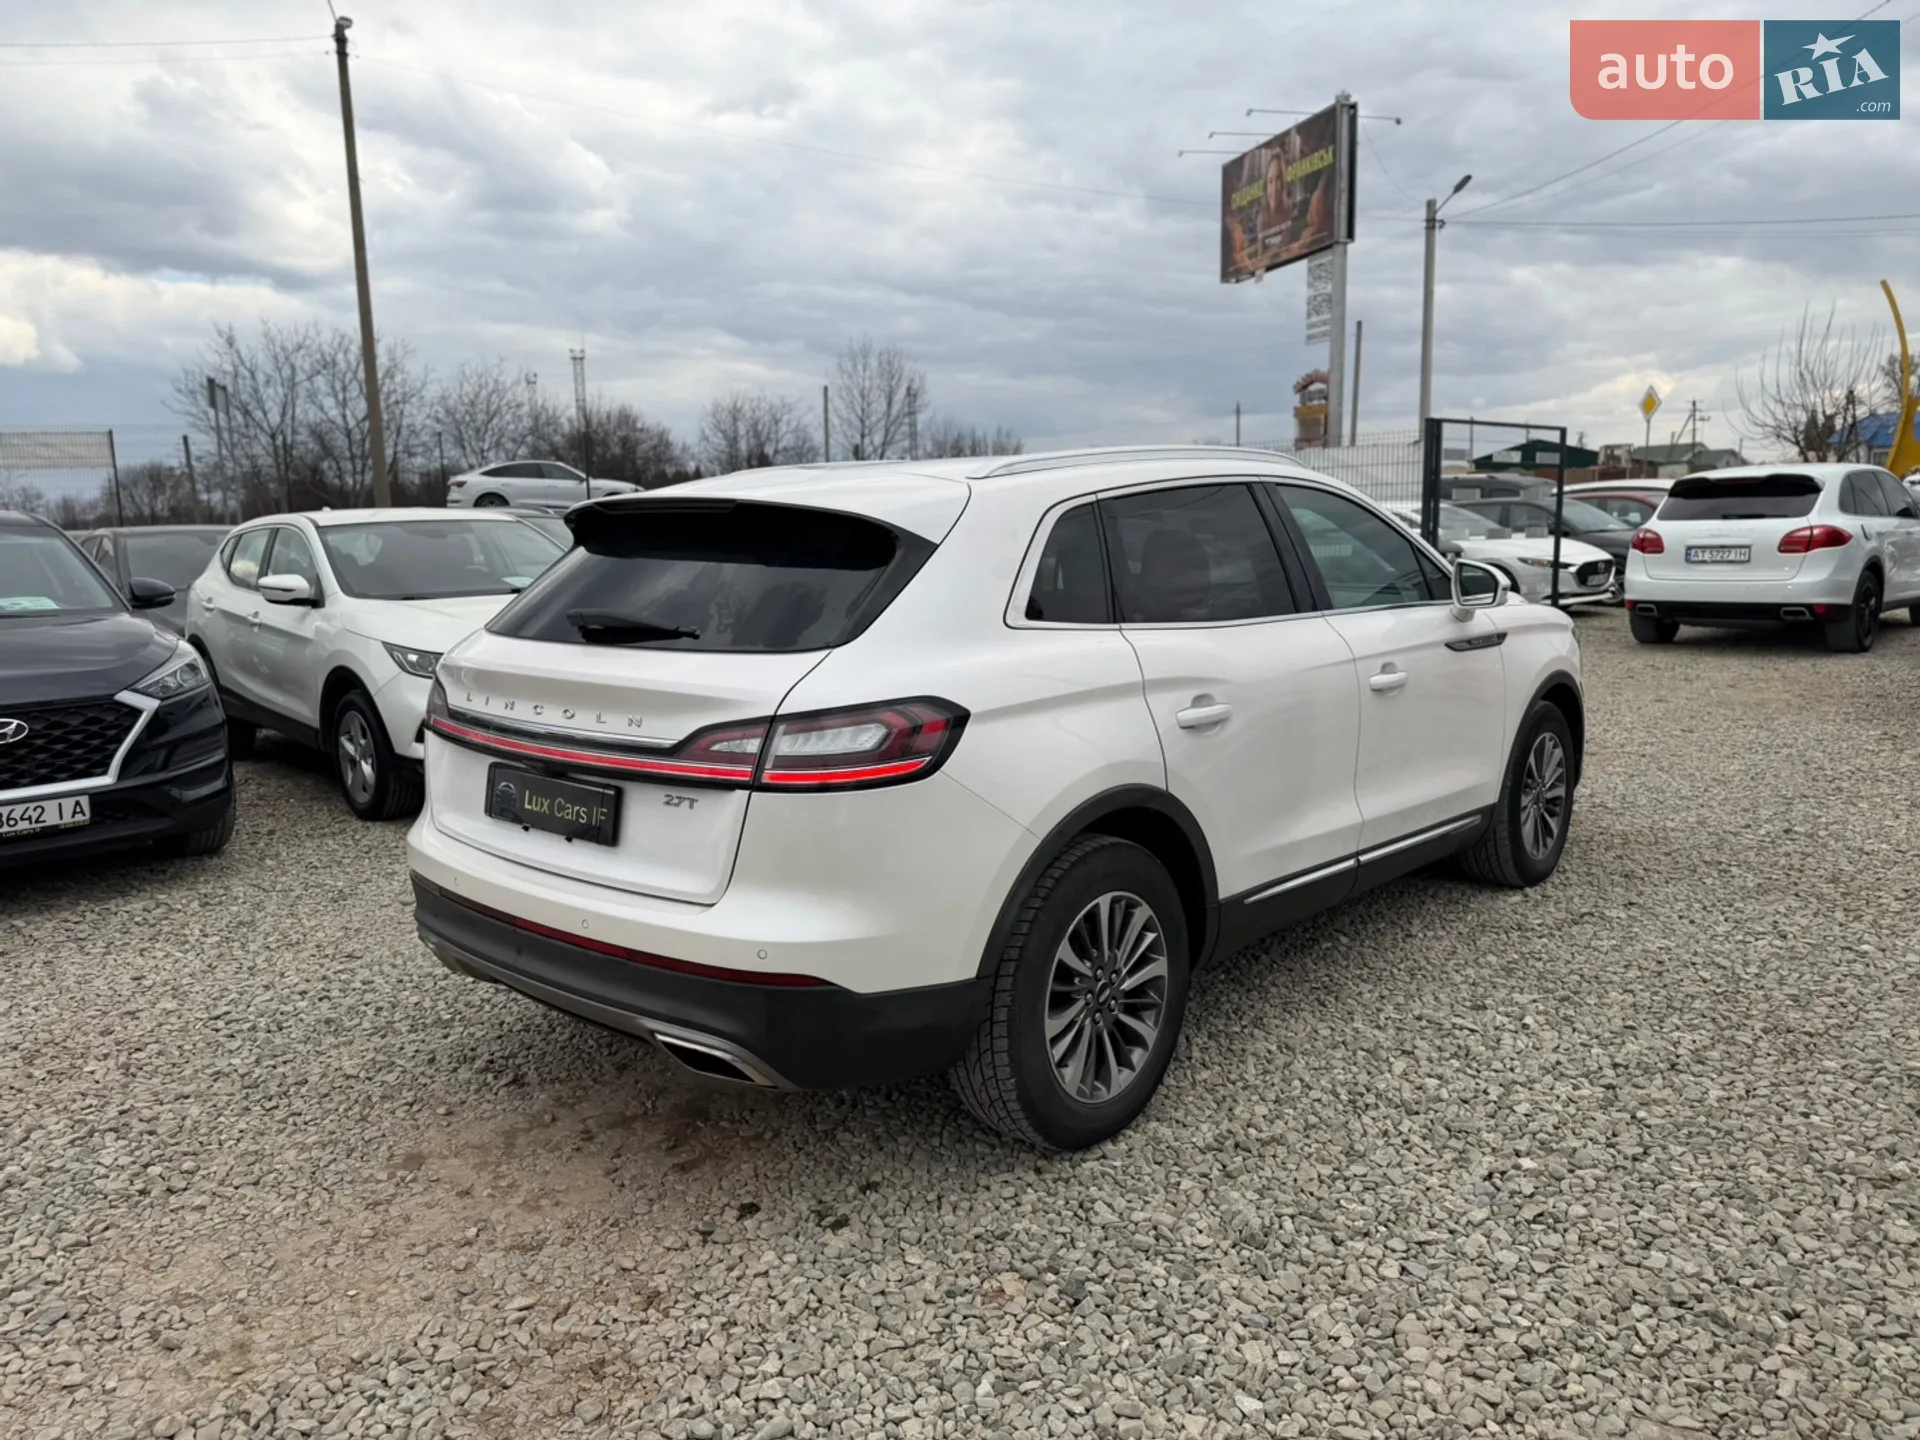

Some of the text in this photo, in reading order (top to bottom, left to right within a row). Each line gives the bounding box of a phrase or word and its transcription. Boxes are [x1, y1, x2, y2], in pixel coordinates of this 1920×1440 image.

[1692, 549, 1706, 560] AT
[466, 692, 643, 728] LINCOLN
[524, 789, 608, 827] Lux Cars IF
